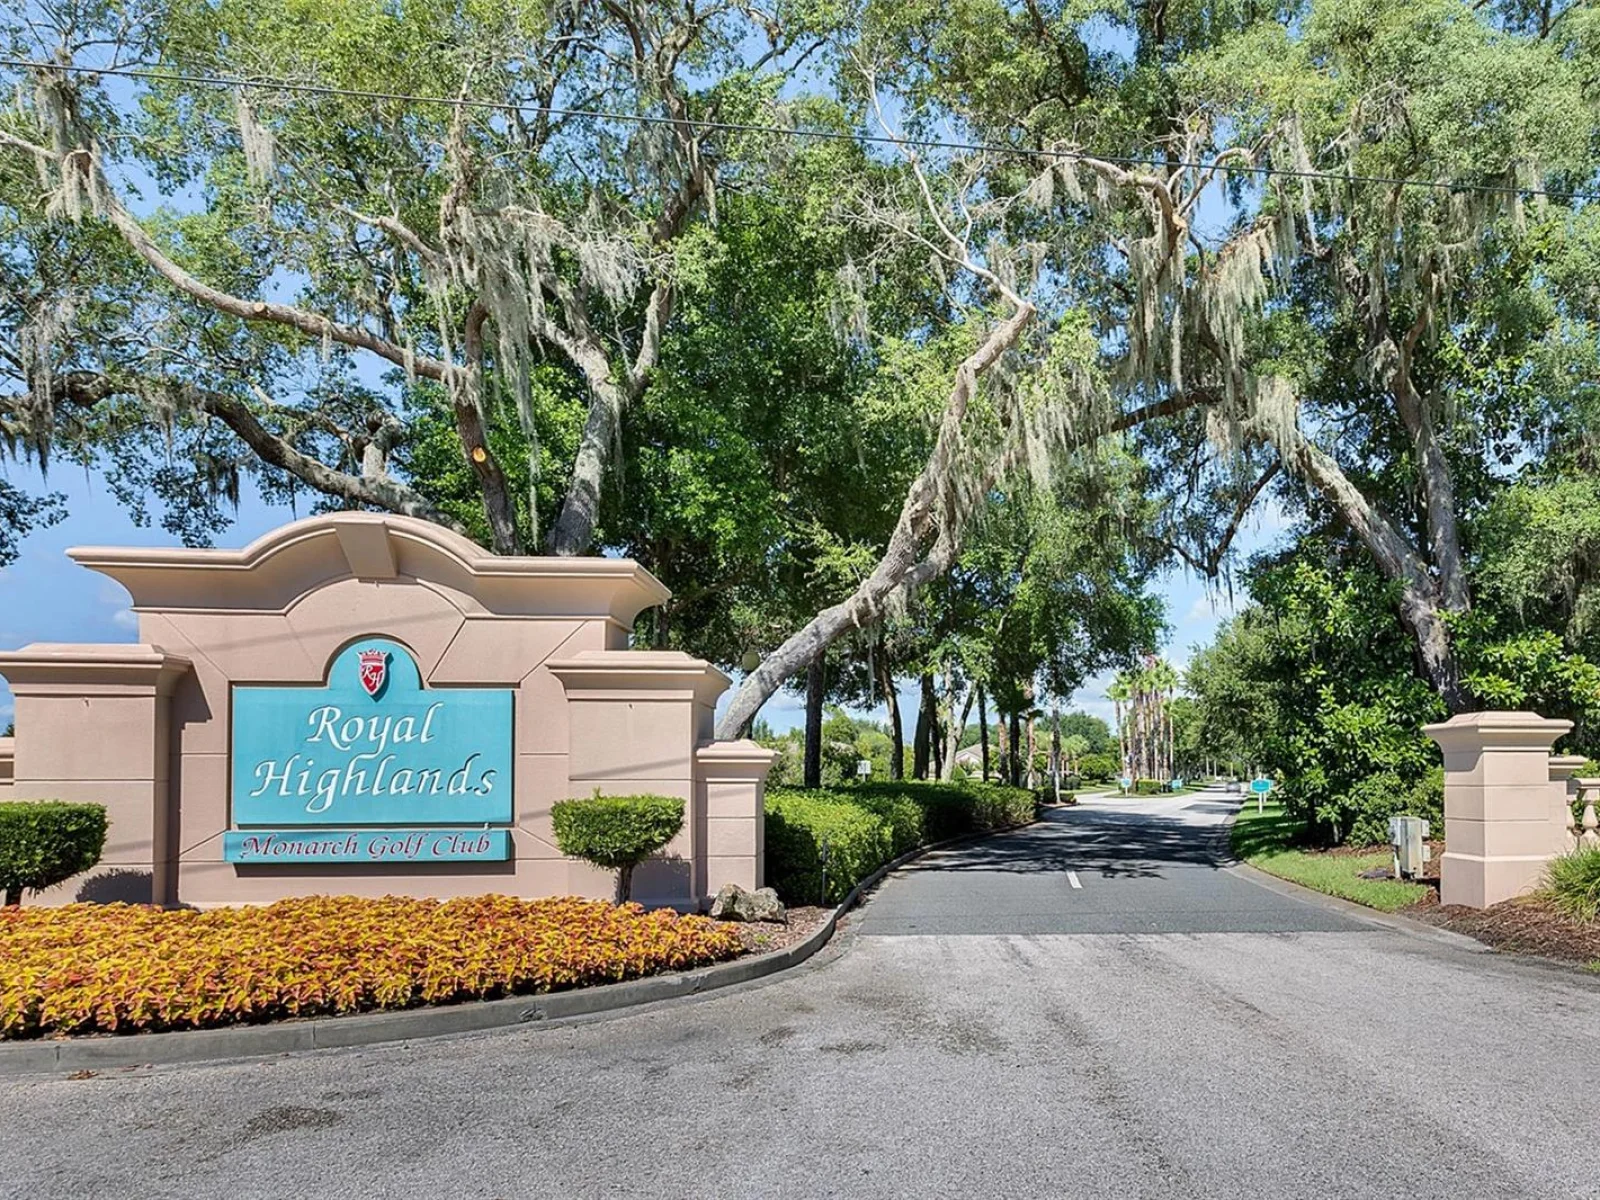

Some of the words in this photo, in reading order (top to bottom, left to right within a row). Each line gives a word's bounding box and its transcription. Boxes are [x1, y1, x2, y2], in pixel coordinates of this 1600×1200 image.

[306, 702, 444, 759] Royal
[250, 754, 497, 813] Highlands
[240, 833, 358, 858] Monarch
[367, 833, 428, 859] Golf
[432, 832, 490, 857] Club
